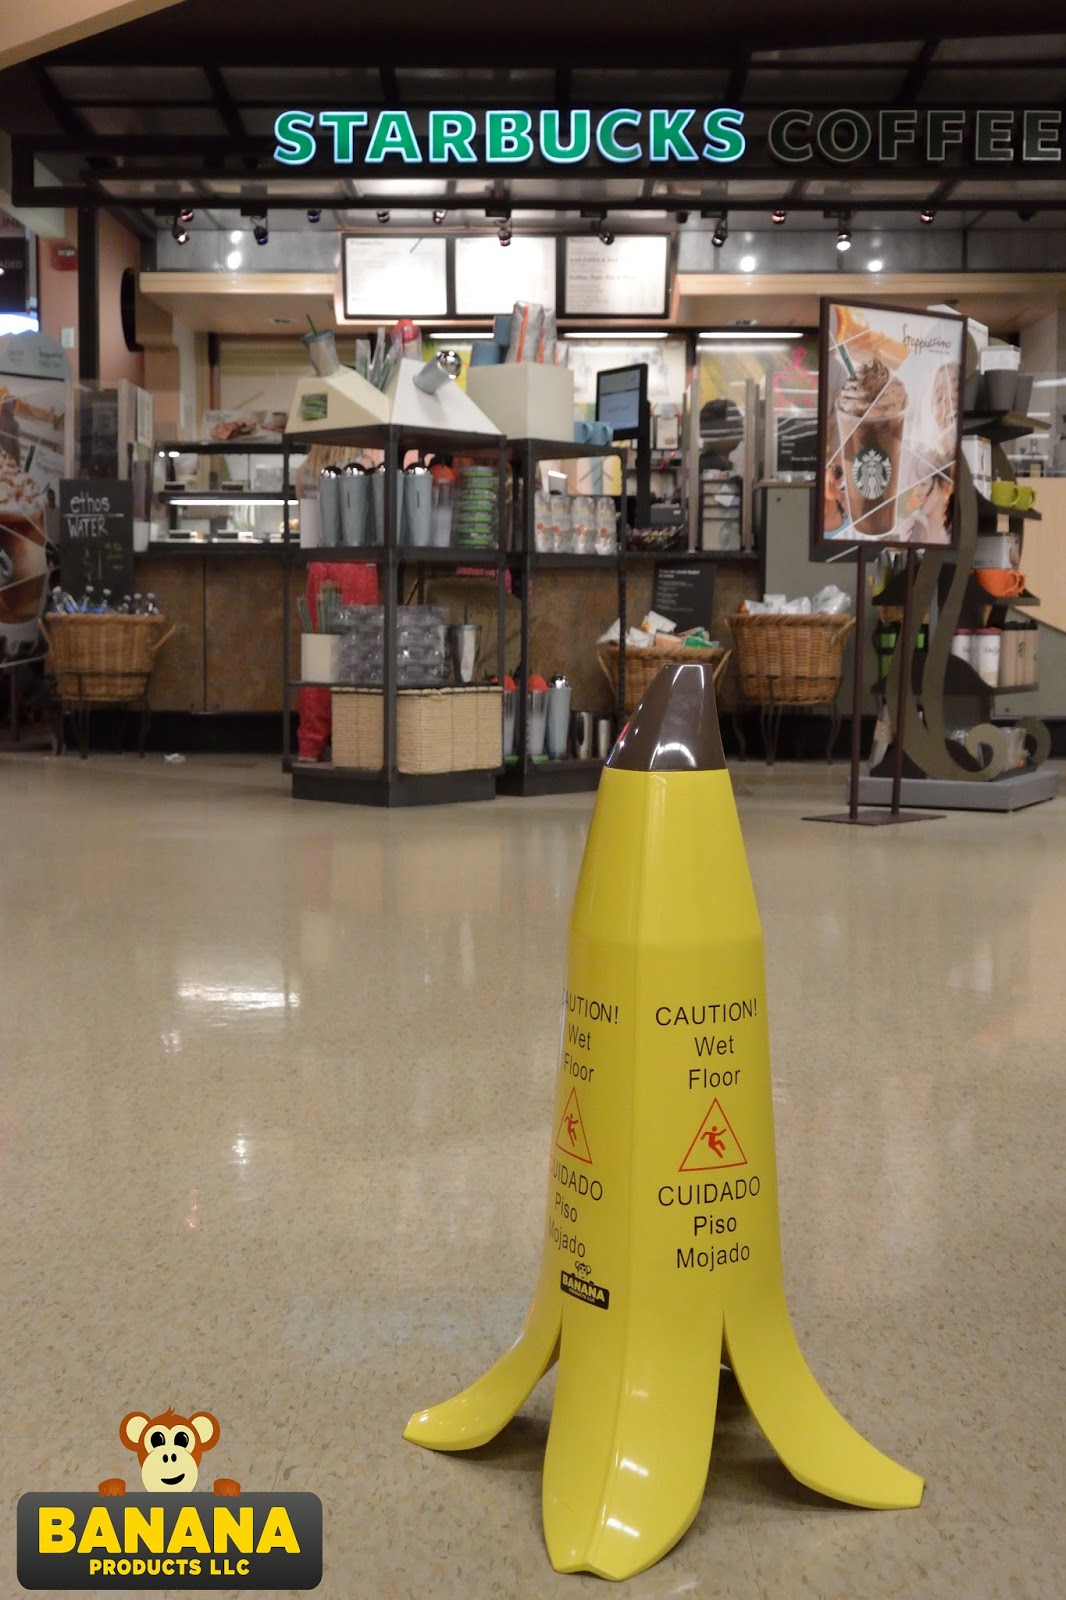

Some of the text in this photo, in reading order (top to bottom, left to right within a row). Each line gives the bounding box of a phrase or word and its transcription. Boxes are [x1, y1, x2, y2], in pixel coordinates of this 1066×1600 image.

[273, 108, 1062, 165] STARBUCKS COFFEE
[70, 491, 110, 513] ethos
[67, 515, 108, 538] WATER
[563, 989, 619, 1025] AUTION!
[655, 998, 758, 1026] CAUTION!
[568, 1022, 592, 1050] Wet
[694, 1035, 734, 1057] Wet
[564, 1052, 594, 1083] Floor
[688, 1069, 741, 1089] Floor
[551, 1158, 603, 1201] UIDADO
[658, 1175, 760, 1207] CUIDADO
[555, 1192, 578, 1223] Piso
[694, 1214, 737, 1236] Piso
[676, 1243, 750, 1272] Mojado
[562, 1273, 606, 1302] BANANA
